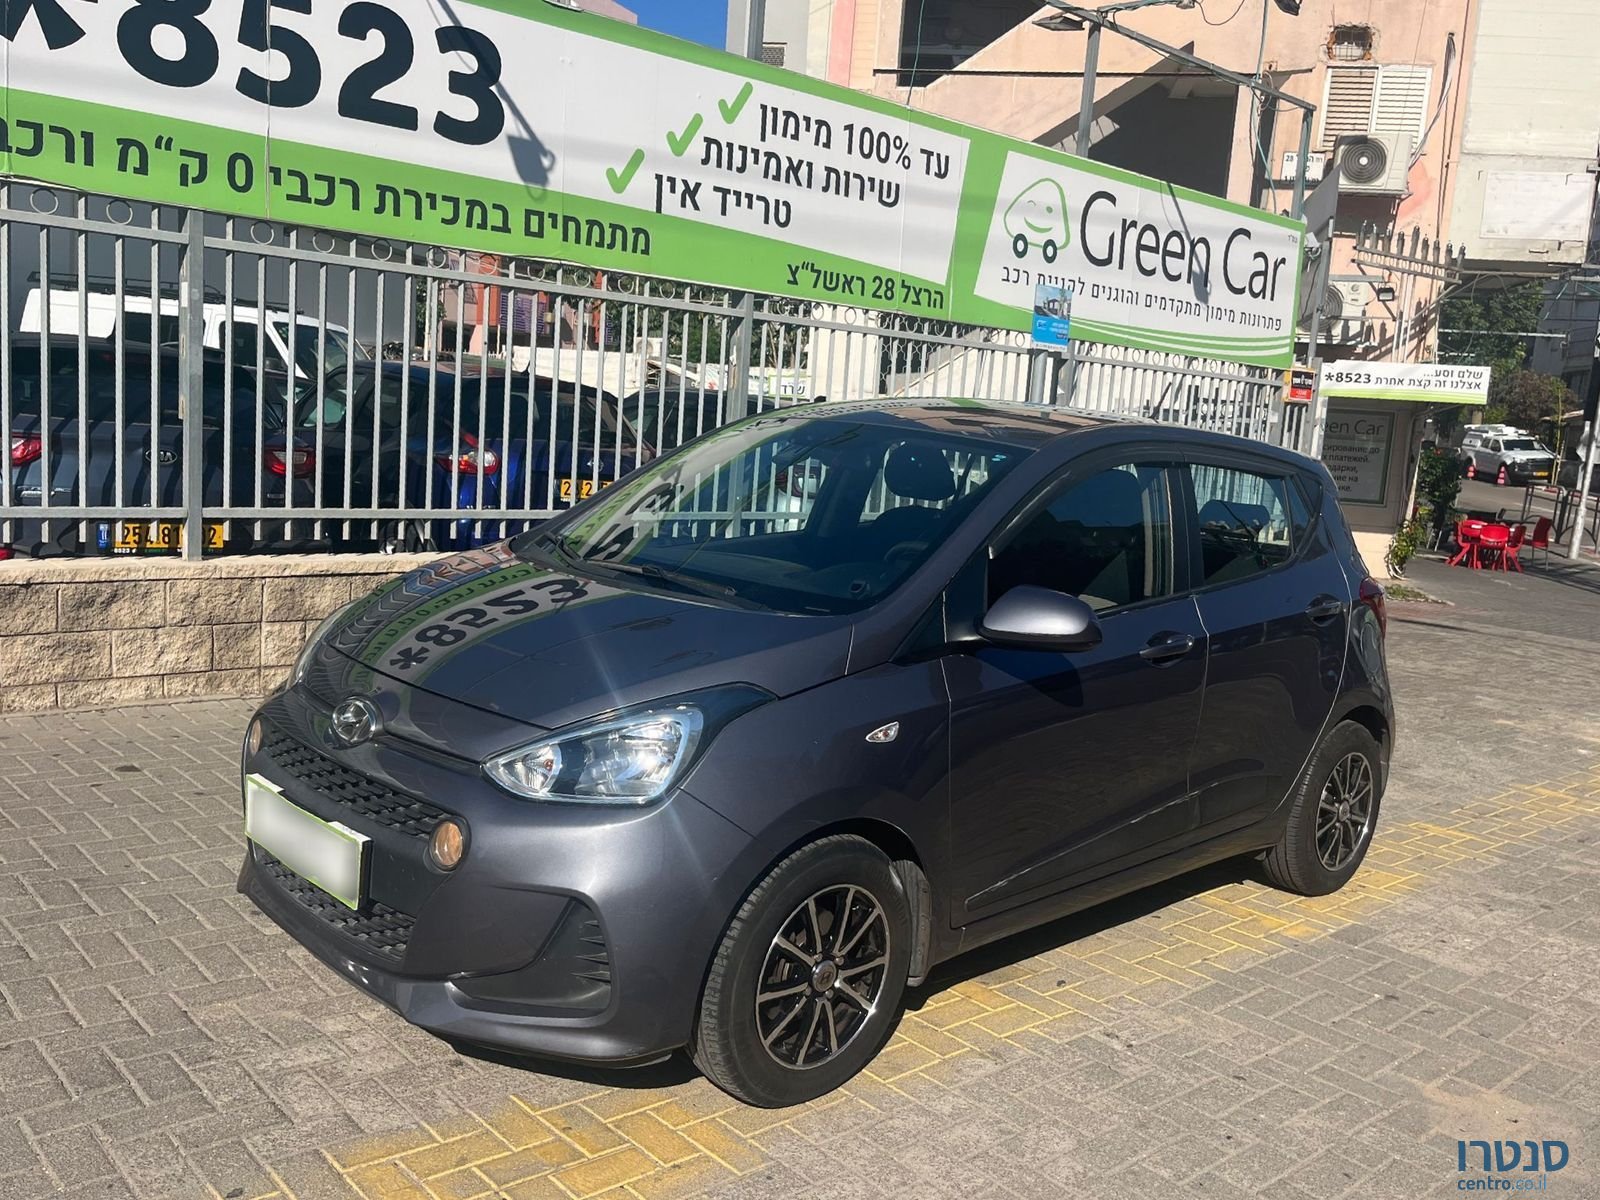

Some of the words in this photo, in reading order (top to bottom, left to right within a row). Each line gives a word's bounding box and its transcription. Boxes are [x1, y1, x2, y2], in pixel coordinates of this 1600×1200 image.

[760, 103, 832, 149] מימון
[843, 123, 912, 170] 100%
[227, 152, 253, 193] 0
[701, 136, 814, 189] ואמינות
[919, 148, 951, 179] עד
[269, 166, 361, 211] רכבי
[655, 173, 702, 214] אין
[821, 167, 901, 208] שירות
[374, 184, 511, 234] במכירת
[713, 185, 792, 228] טרייד
[524, 208, 650, 256] מתמחים
[1080, 190, 1212, 288] Green
[1223, 227, 1287, 302] Car
[871, 275, 896, 301] 28
[1001, 266, 1030, 286] רכב
[900, 279, 945, 310] הרצל
[1091, 283, 1140, 306] והוגנים
[1145, 294, 1201, 317] מתקדמים
[1206, 304, 1236, 322] מימון
[1239, 312, 1282, 331] פתרונות
[1374, 376, 1405, 386] אחרת
[1407, 377, 1431, 389] קצת
[1434, 379, 1447, 387] זה
[1450, 379, 1482, 390] אצלנו
[1458, 369, 1484, 379] שלם
[1354, 420, 1385, 435] Car
